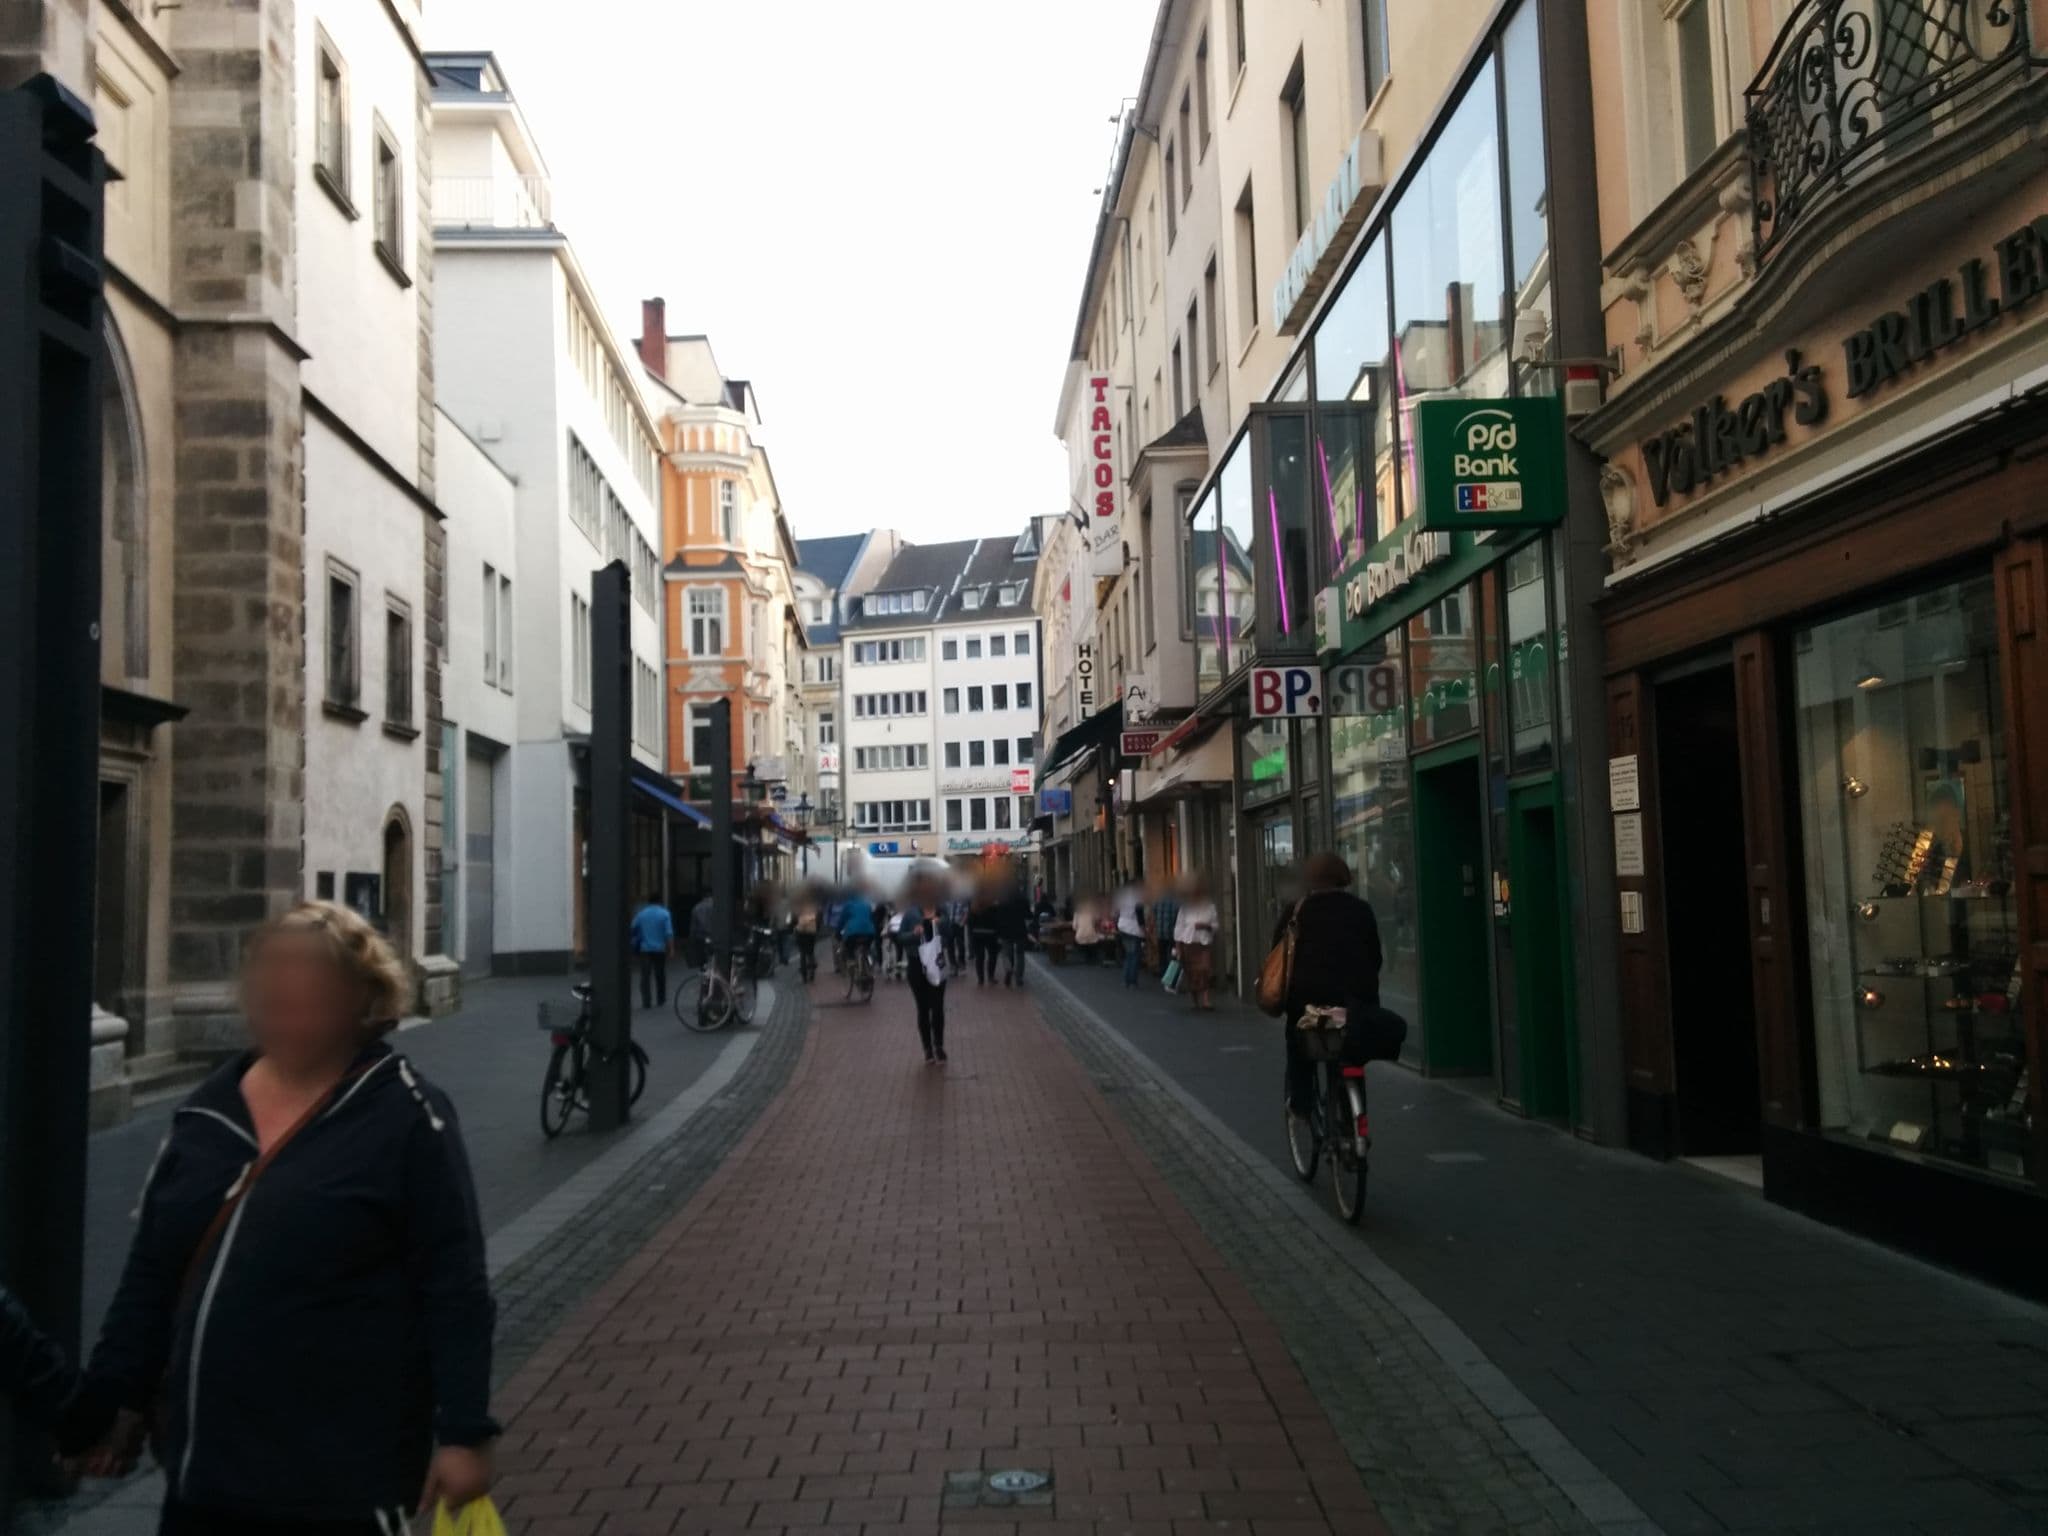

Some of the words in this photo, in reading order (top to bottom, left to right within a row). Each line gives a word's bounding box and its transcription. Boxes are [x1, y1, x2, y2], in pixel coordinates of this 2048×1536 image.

[1090, 377, 1114, 517] TACOS
[1467, 423, 1517, 452] psd
[1454, 453, 1519, 477] Bank
[1094, 524, 1119, 547] BAR
[1367, 548, 1408, 605] Bank
[1078, 644, 1093, 721] HOTEL
